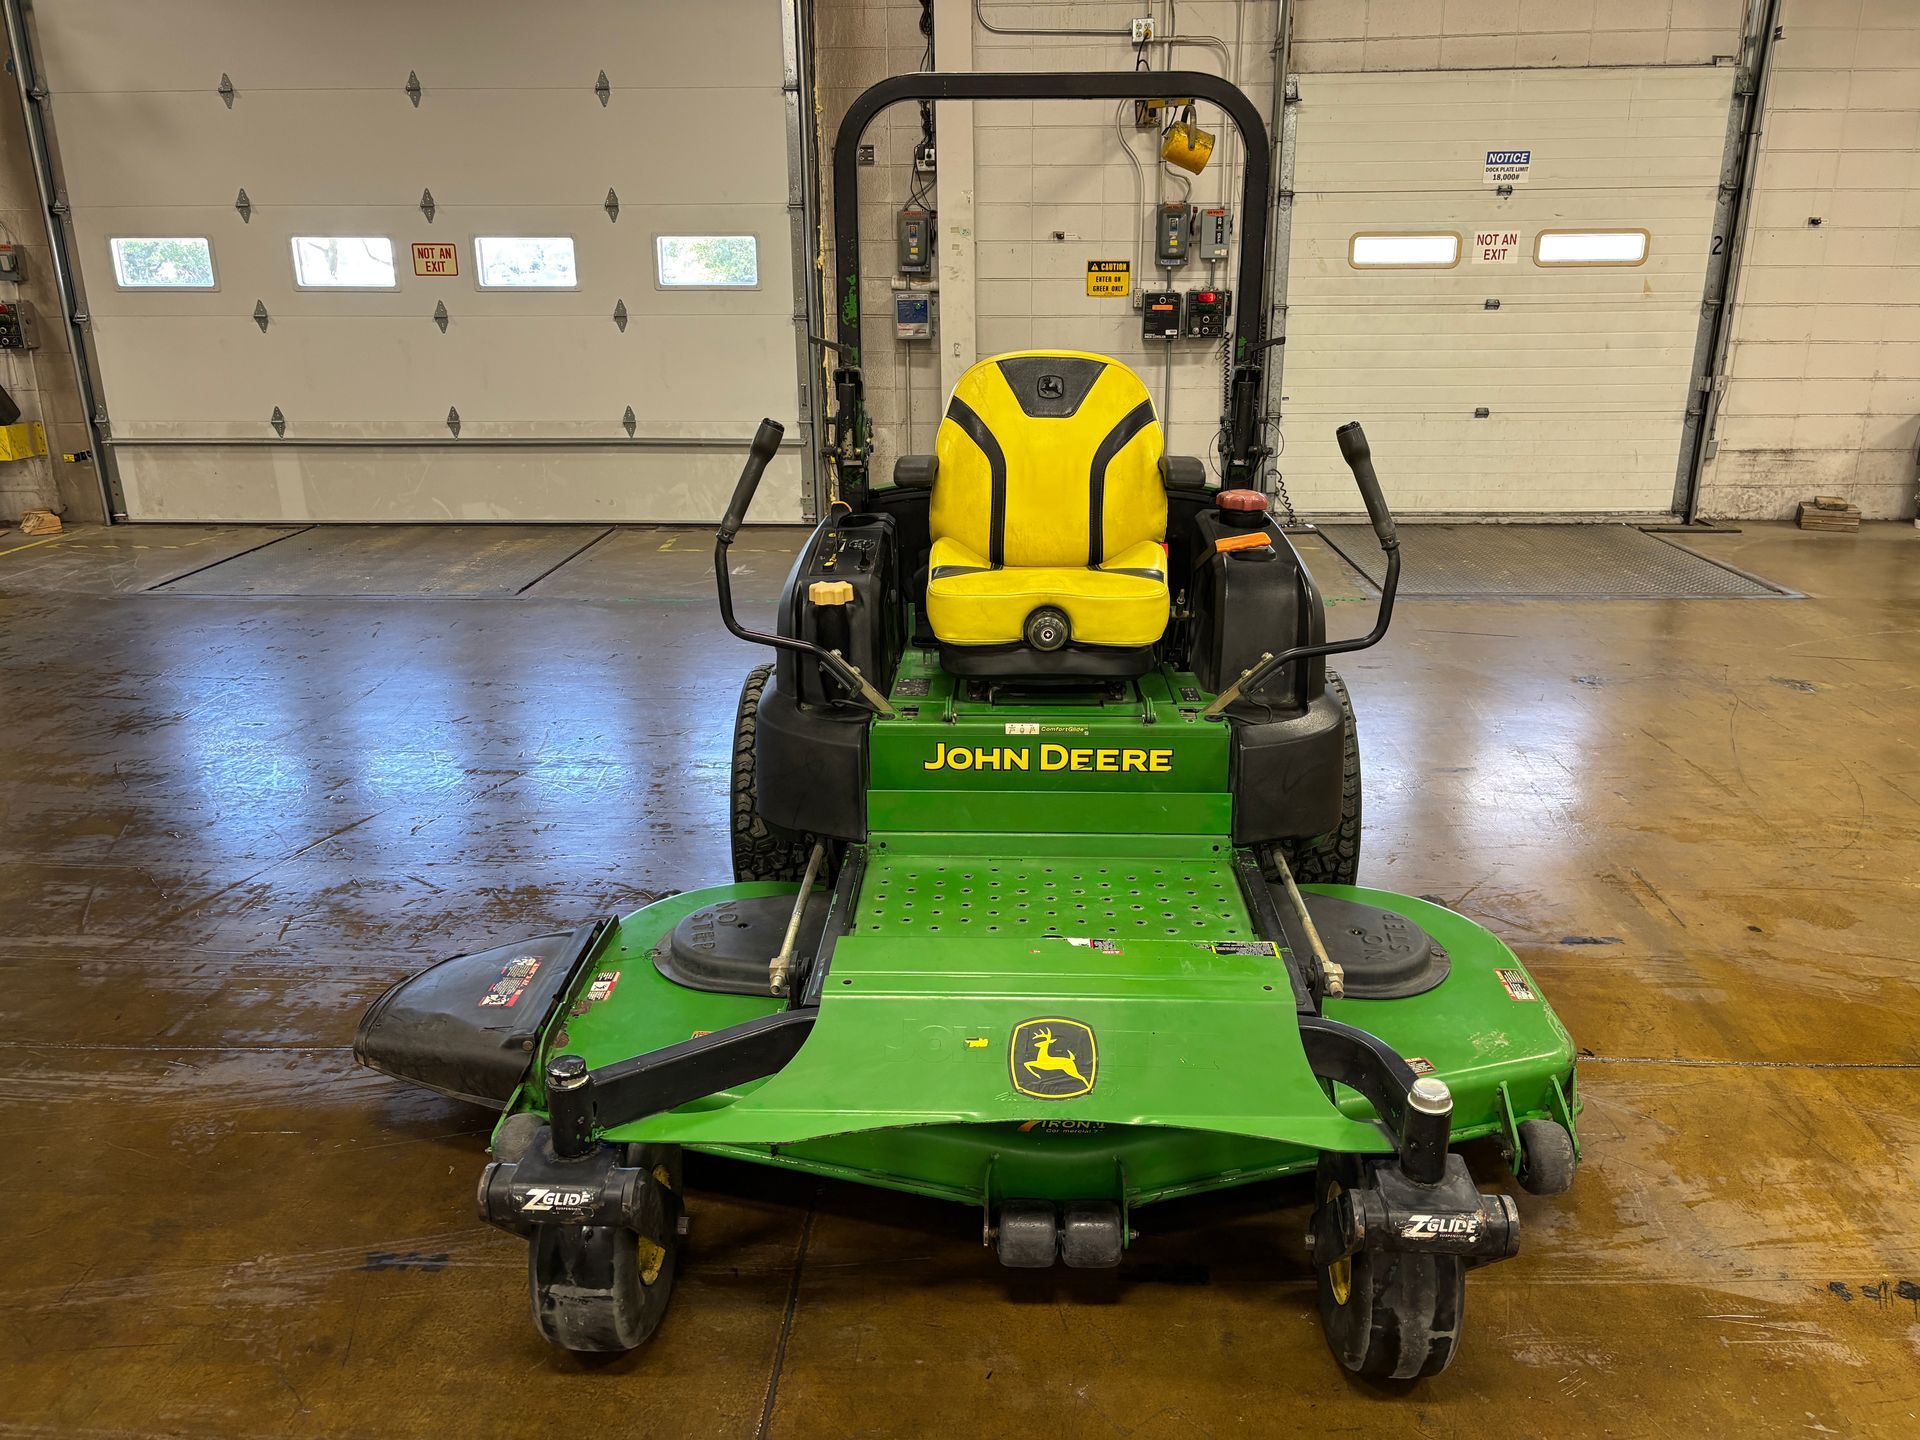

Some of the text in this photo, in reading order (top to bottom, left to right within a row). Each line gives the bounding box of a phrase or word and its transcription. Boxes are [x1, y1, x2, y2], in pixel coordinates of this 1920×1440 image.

[1488, 152, 1529, 163] NOTICE
[1476, 233, 1518, 246] NOT AN
[1712, 235, 1723, 256] 2
[417, 247, 452, 259] NOT AN
[1483, 248, 1508, 261] EXIT
[425, 260, 446, 272] EXIT
[1101, 263, 1127, 271] CAUTION
[923, 742, 1174, 772] JOHN DEERE
